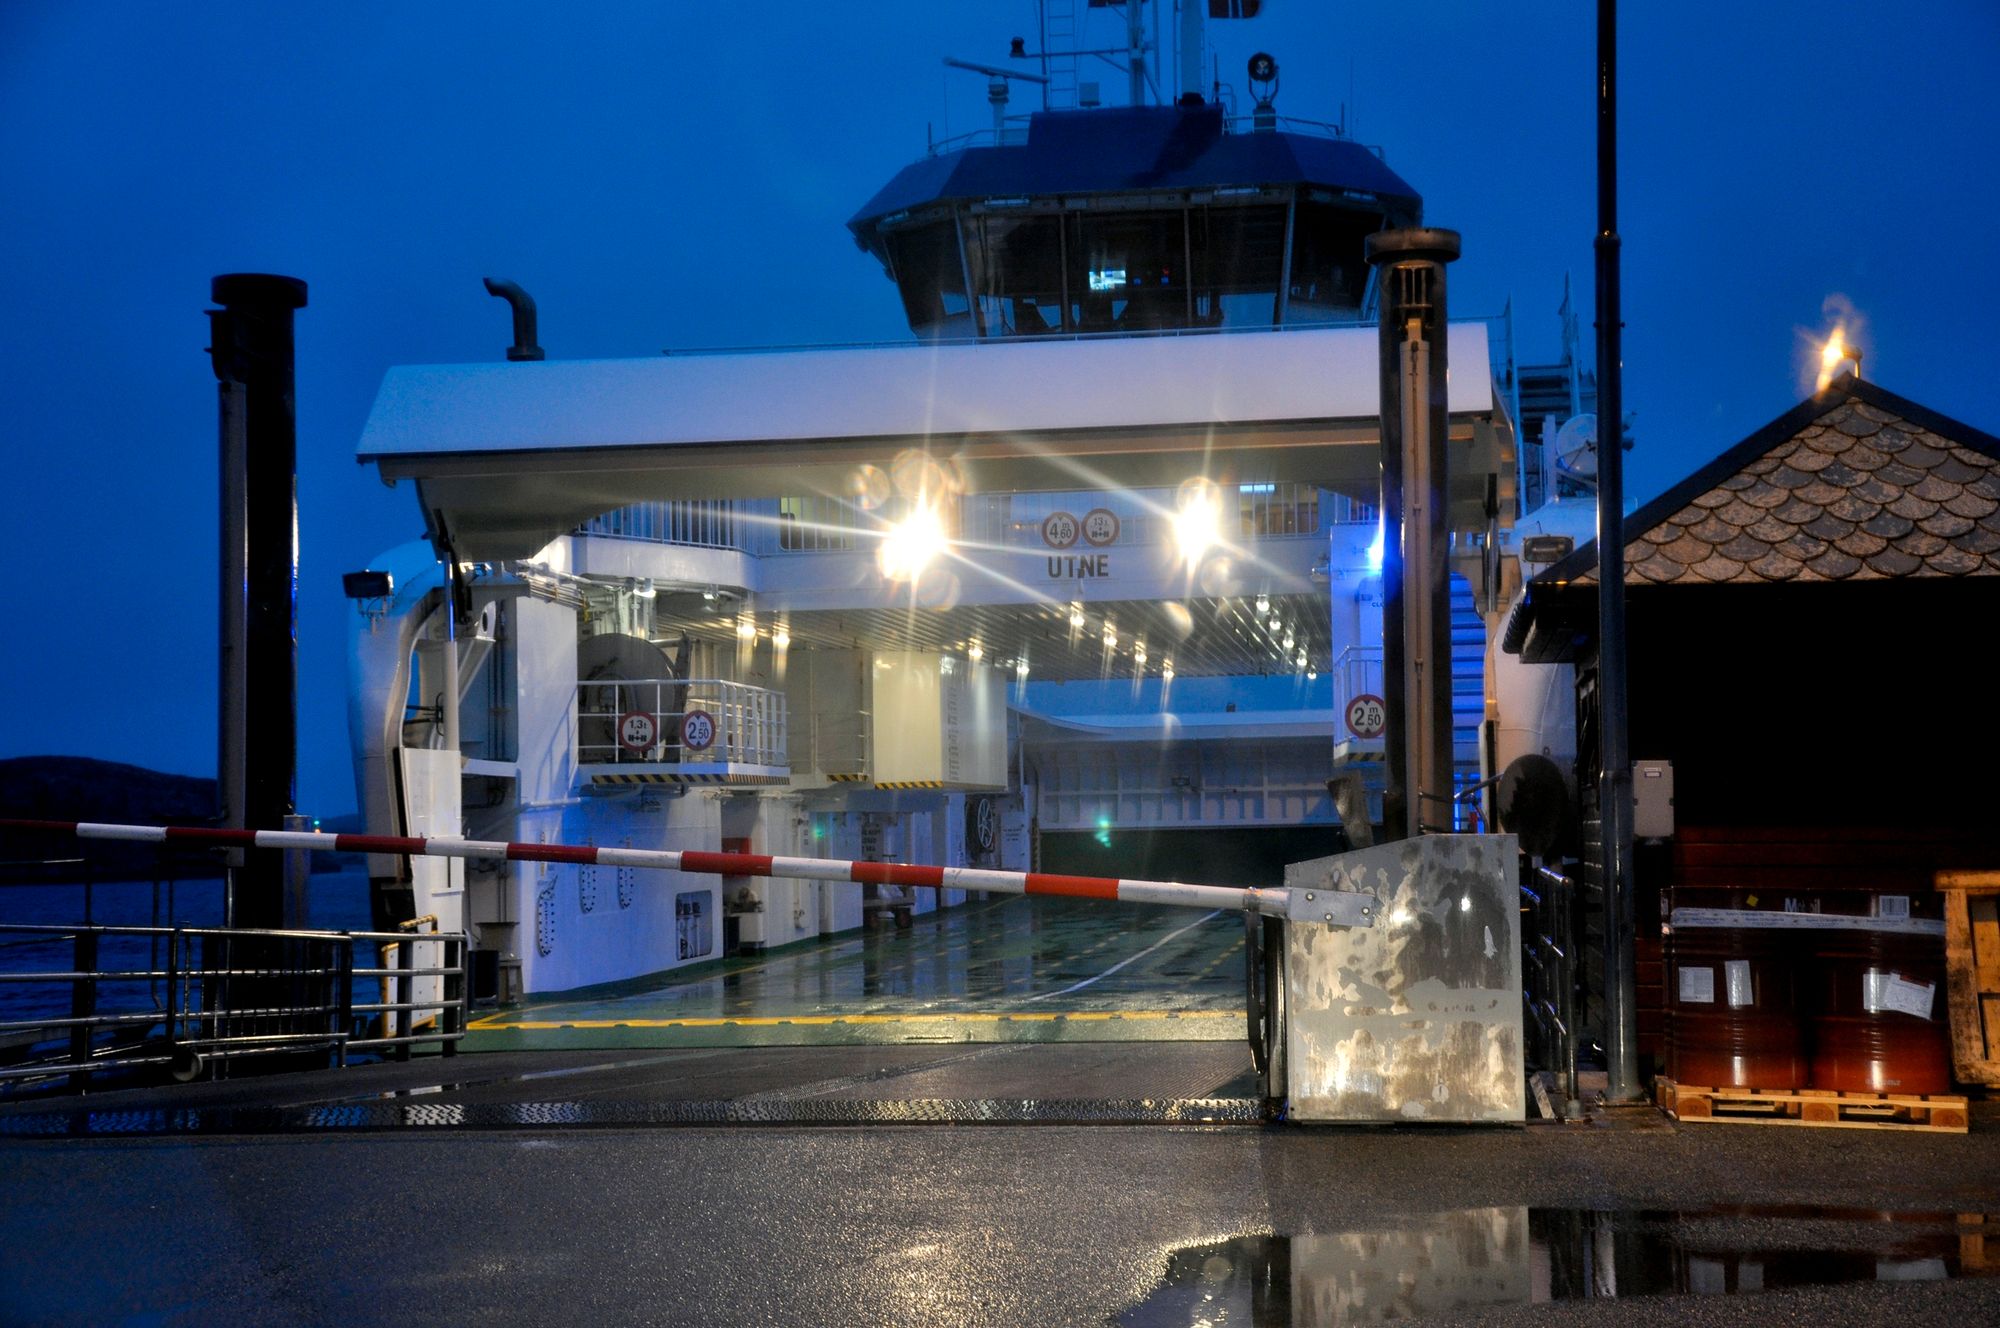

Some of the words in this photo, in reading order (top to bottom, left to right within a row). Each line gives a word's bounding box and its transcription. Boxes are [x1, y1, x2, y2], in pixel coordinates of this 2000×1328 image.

[1049, 522, 1059, 539] 4
[1060, 528, 1072, 539] 60
[1047, 554, 1109, 578] UTNE
[1354, 707, 1365, 726] 2
[1367, 714, 1381, 726] 50
[688, 721, 697, 739] 2
[698, 727, 710, 739] 50
